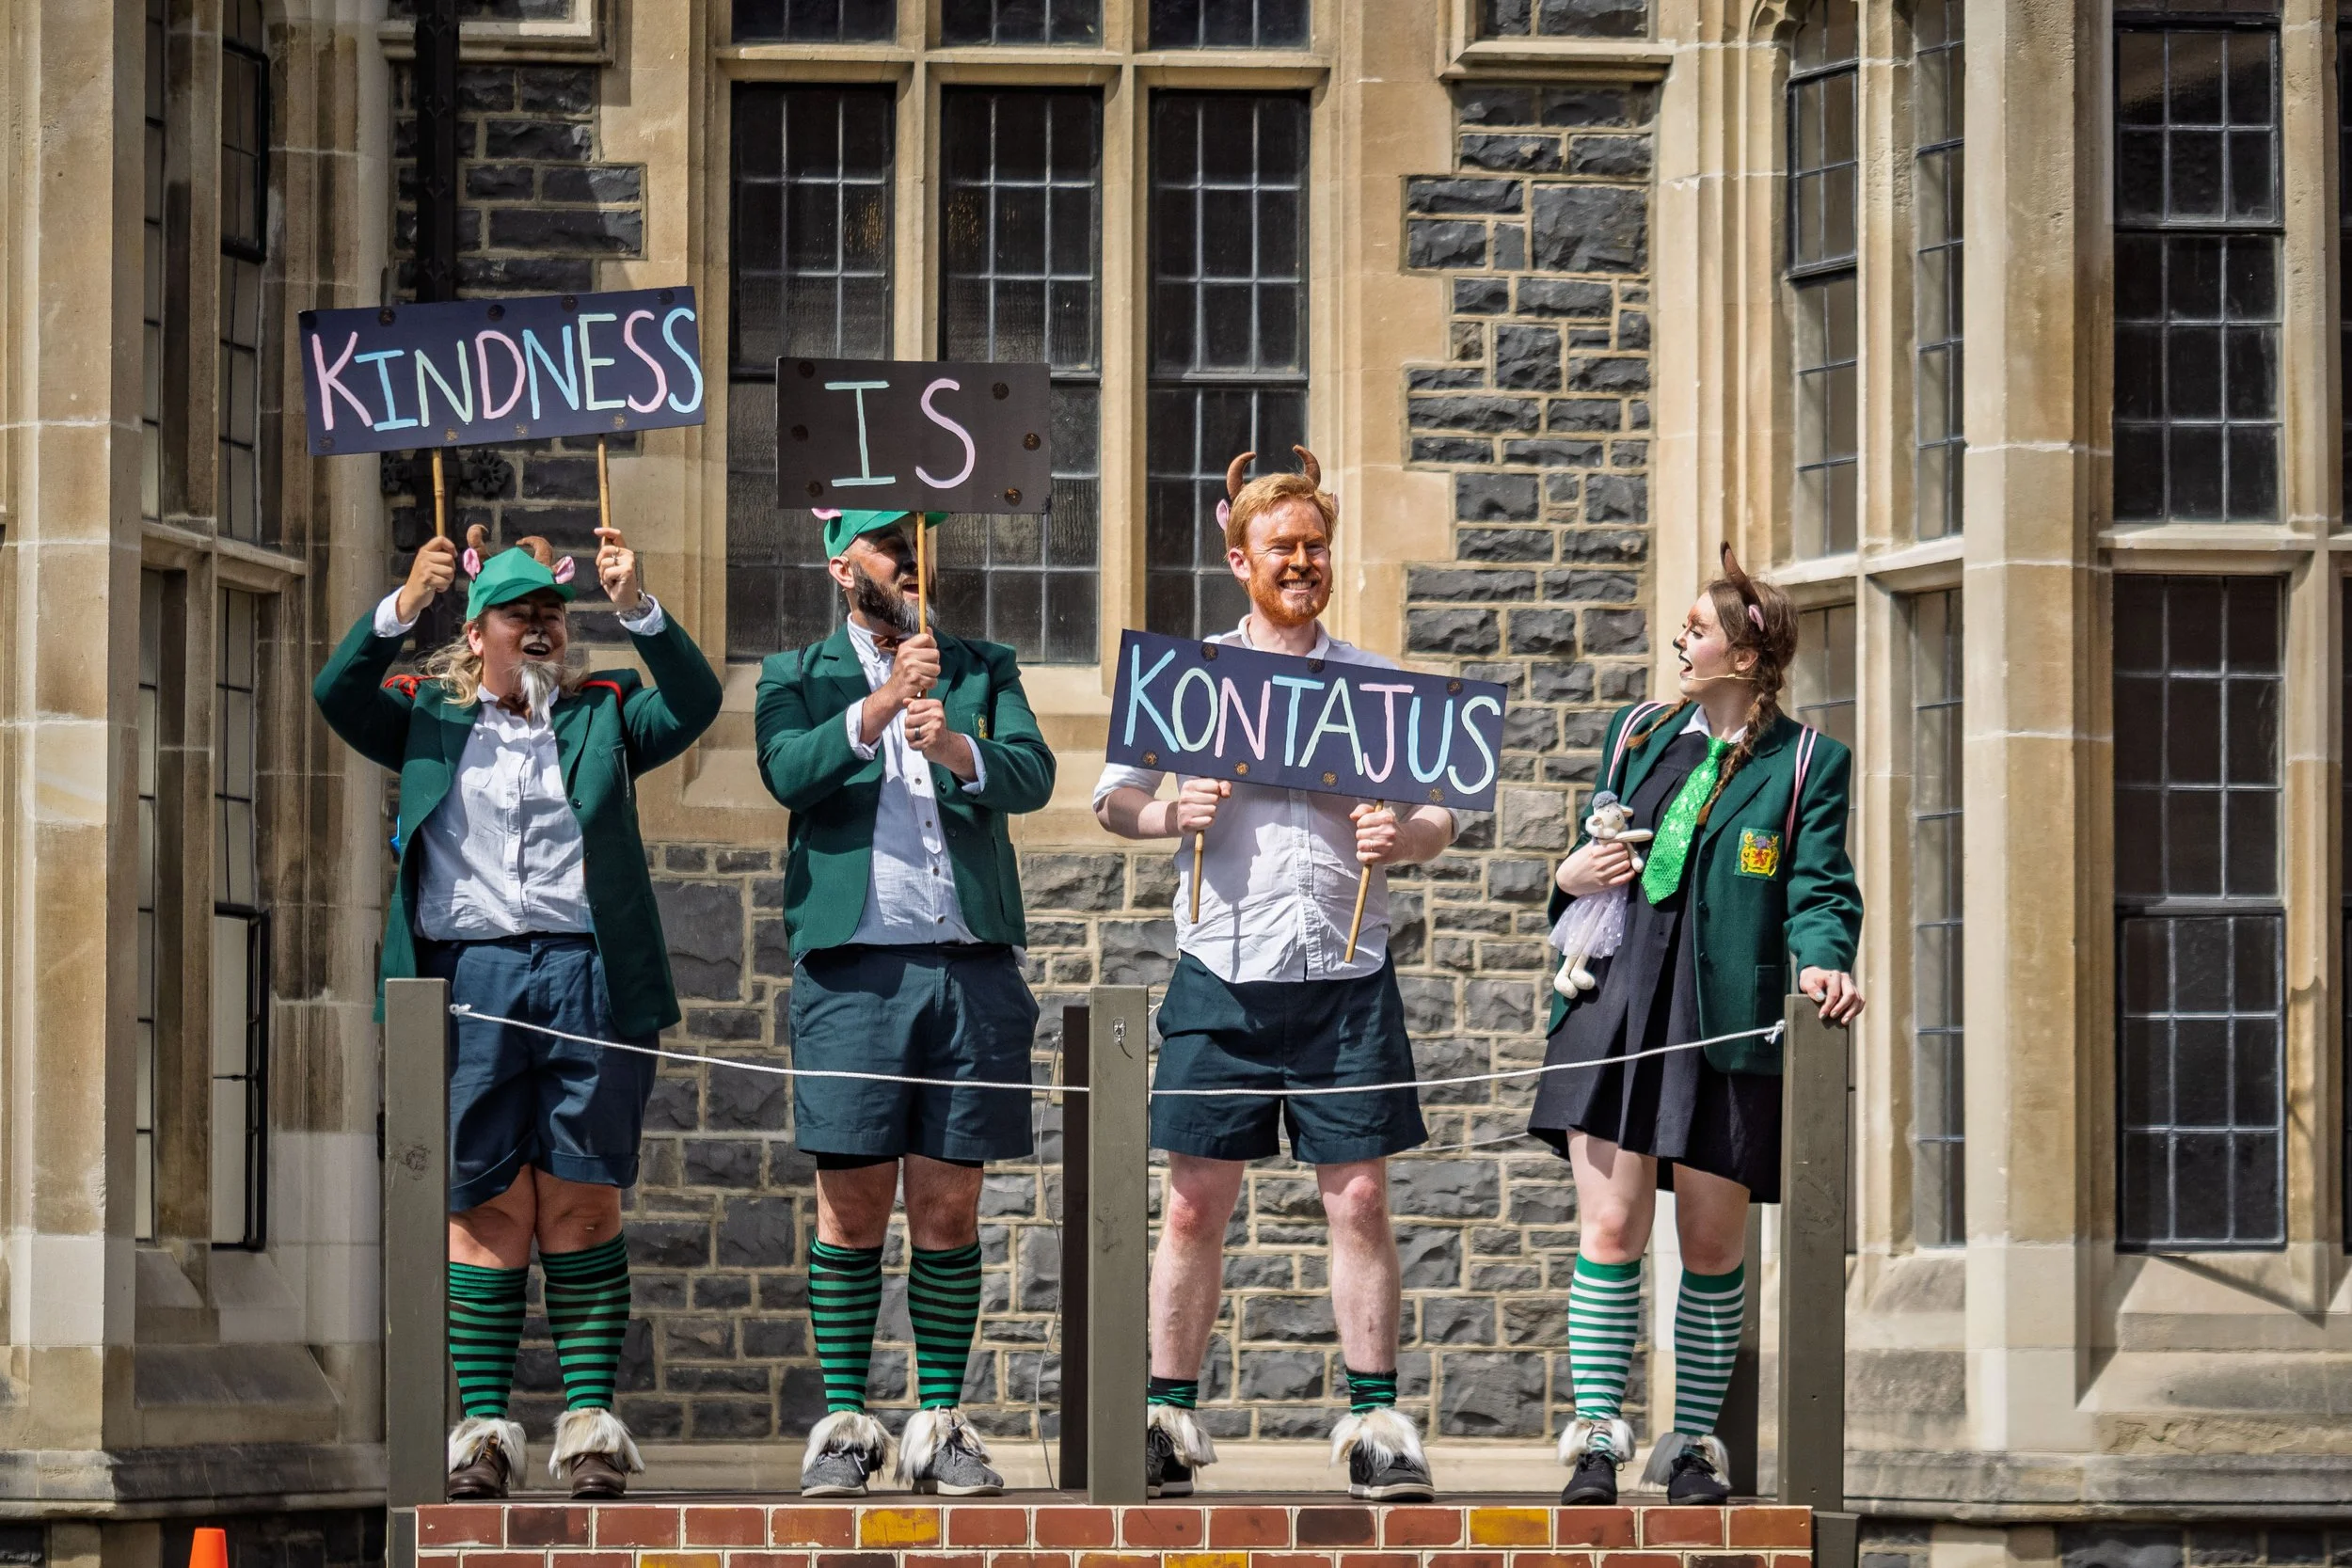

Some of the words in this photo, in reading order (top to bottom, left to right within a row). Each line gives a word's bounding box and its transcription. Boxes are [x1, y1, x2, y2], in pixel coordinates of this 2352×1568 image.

[311, 308, 704, 432] KINDNESS
[824, 378, 976, 489] IS
[1123, 643, 1502, 796] KONTAJUS
